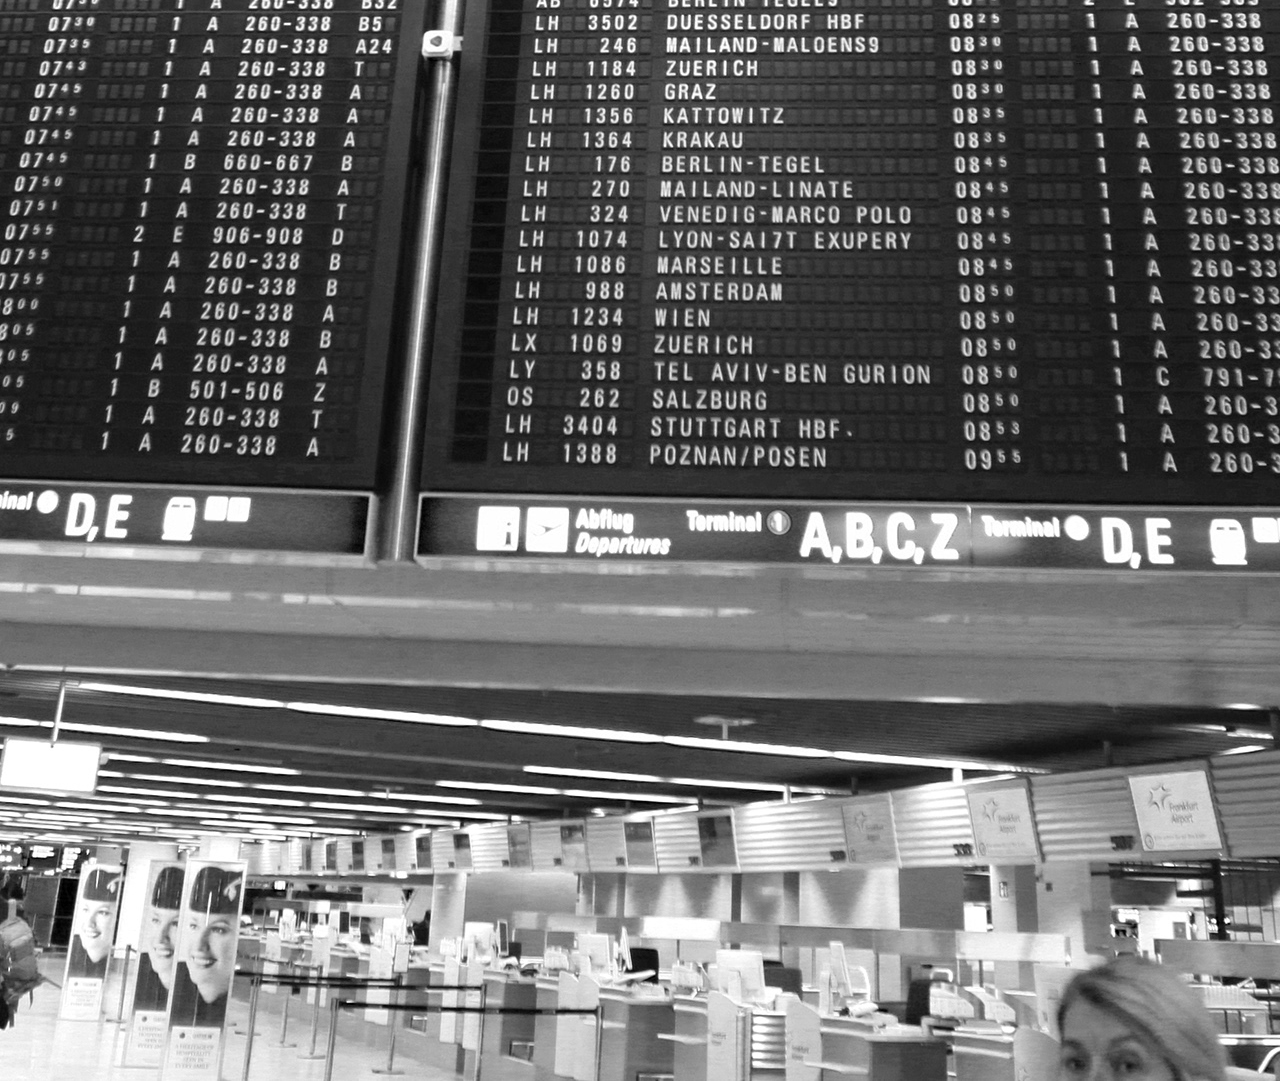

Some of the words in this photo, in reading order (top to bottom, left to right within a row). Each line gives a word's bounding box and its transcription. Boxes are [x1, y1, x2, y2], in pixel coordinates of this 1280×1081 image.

[664, 107, 784, 124] KATTOWITZ
[224, 154, 313, 171] 660-667
[660, 206, 840, 223] VENEDIG-MARCO
[857, 206, 911, 224] POLO
[213, 227, 303, 244] 906-908
[815, 232, 911, 249] EXUPERY
[656, 282, 782, 301] AMSTERDAM
[655, 362, 693, 381] TEL
[712, 363, 826, 383] AVIV-BEN
[844, 364, 931, 385] GURION
[190, 380, 283, 401] 501-506
[651, 417, 780, 438] STUTTGART
[650, 445, 826, 467] POZNAN/POSEN
[64, 493, 133, 542] D,E
[575, 508, 634, 533] Abflug
[686, 509, 762, 532] Terminal
[800, 511, 960, 564] A,B,C,Z
[981, 515, 1061, 539] Terminal
[1101, 518, 1175, 569] D,E
[575, 532, 670, 556] Departures
